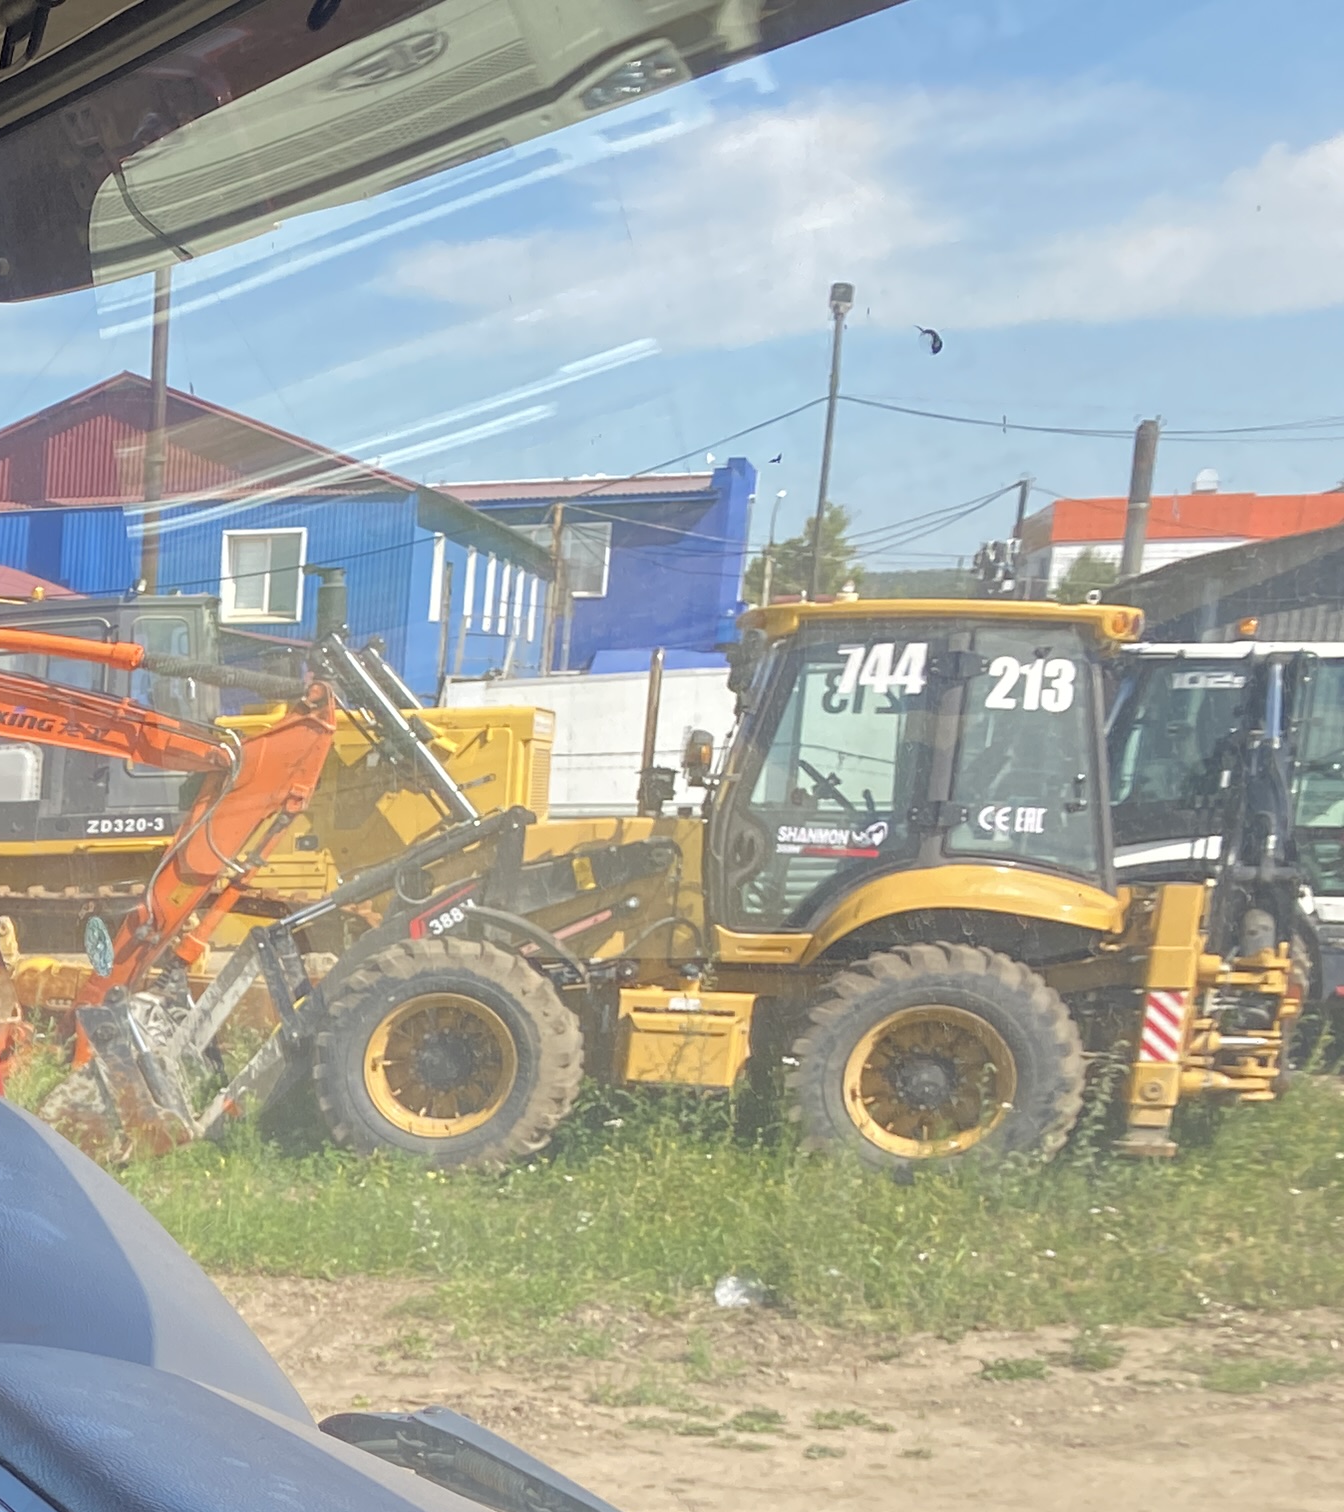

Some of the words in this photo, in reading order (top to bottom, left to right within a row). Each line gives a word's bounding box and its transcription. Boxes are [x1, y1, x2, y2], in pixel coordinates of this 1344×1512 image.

[837, 643, 928, 694] 744
[984, 656, 1076, 712] 213
[86, 817, 164, 834] ZD320-3
[978, 805, 1012, 831] CE
[777, 825, 850, 845] SHANMON
